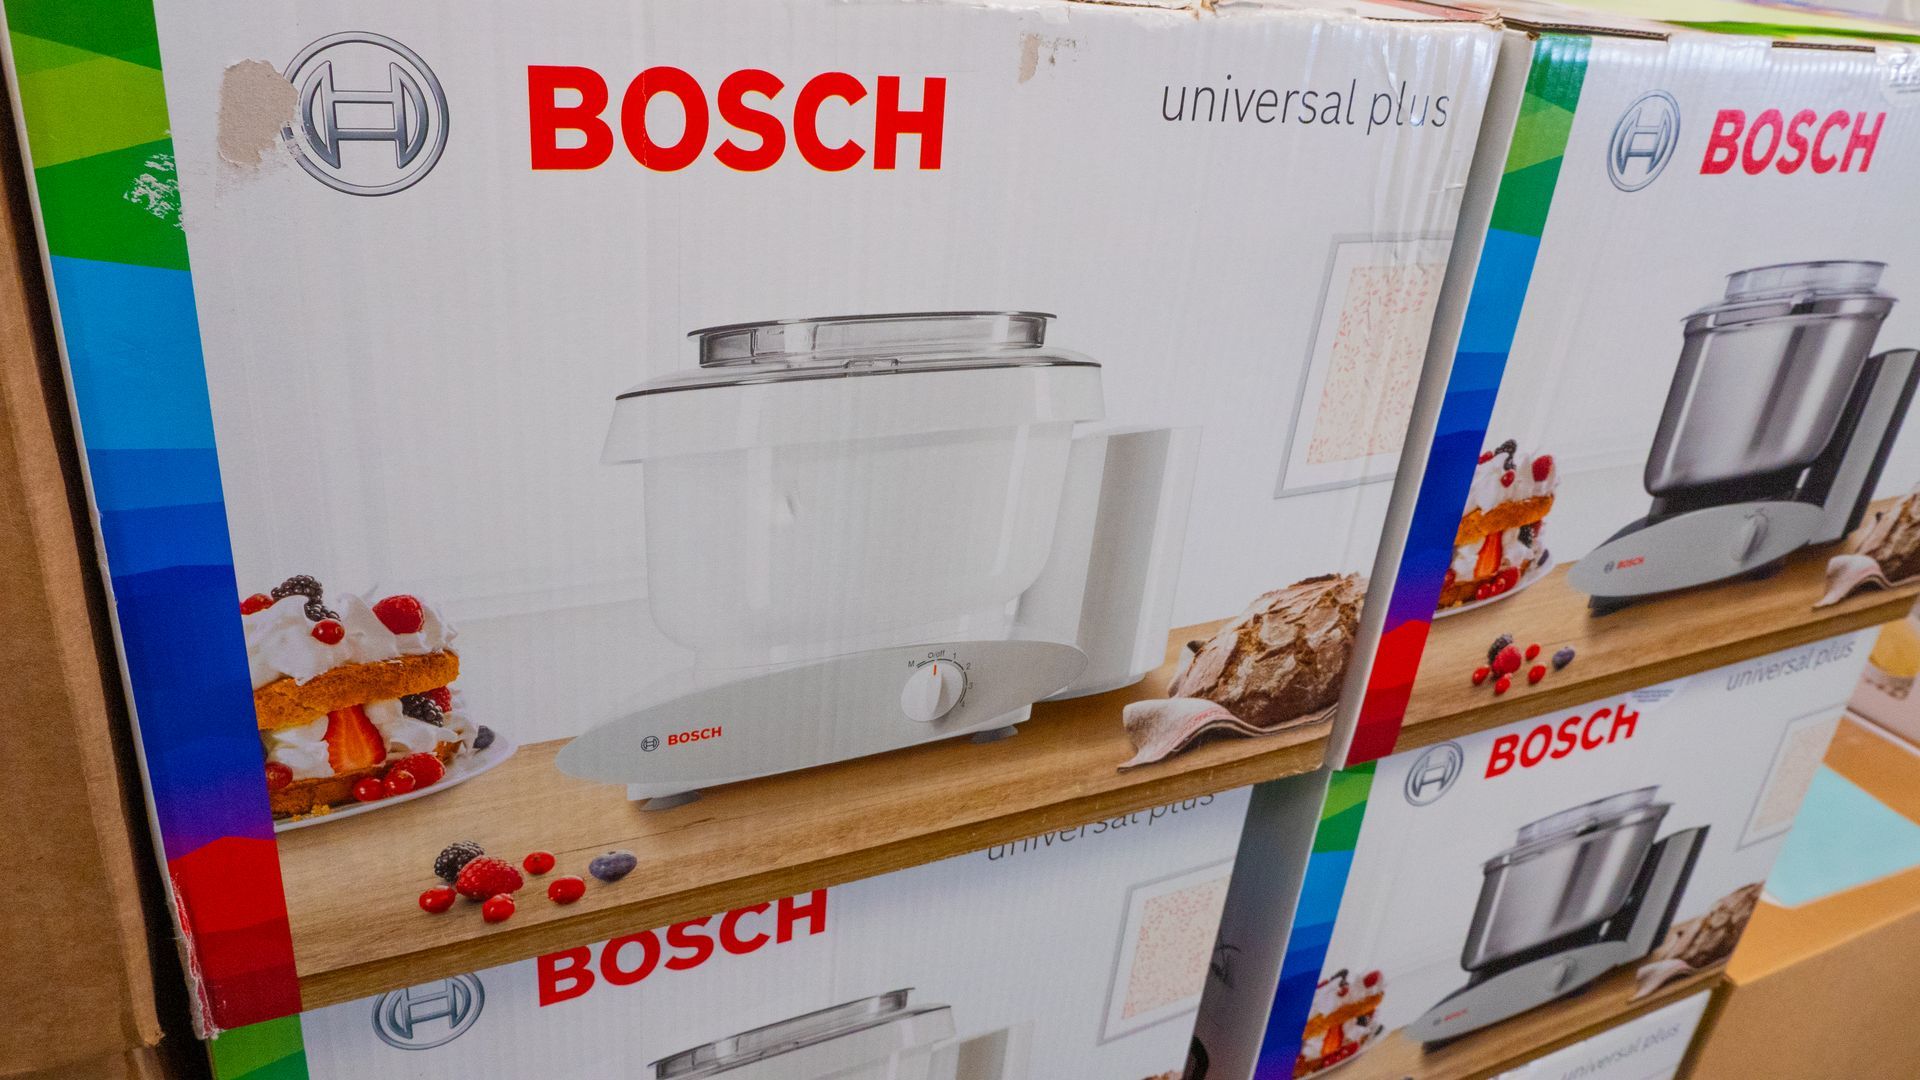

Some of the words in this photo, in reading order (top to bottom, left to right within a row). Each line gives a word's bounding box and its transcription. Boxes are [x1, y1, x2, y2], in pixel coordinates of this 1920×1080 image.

[527, 64, 947, 172] BOSCH
[1162, 74, 1356, 125] universal
[1366, 81, 1450, 136] plus
[1699, 108, 1887, 176] BOSCH
[1726, 646, 1813, 692] universal
[1813, 640, 1857, 671] plus
[667, 725, 722, 746] BOSCH
[1484, 703, 1640, 780] BOSCH
[537, 888, 828, 1007] BOSCH
